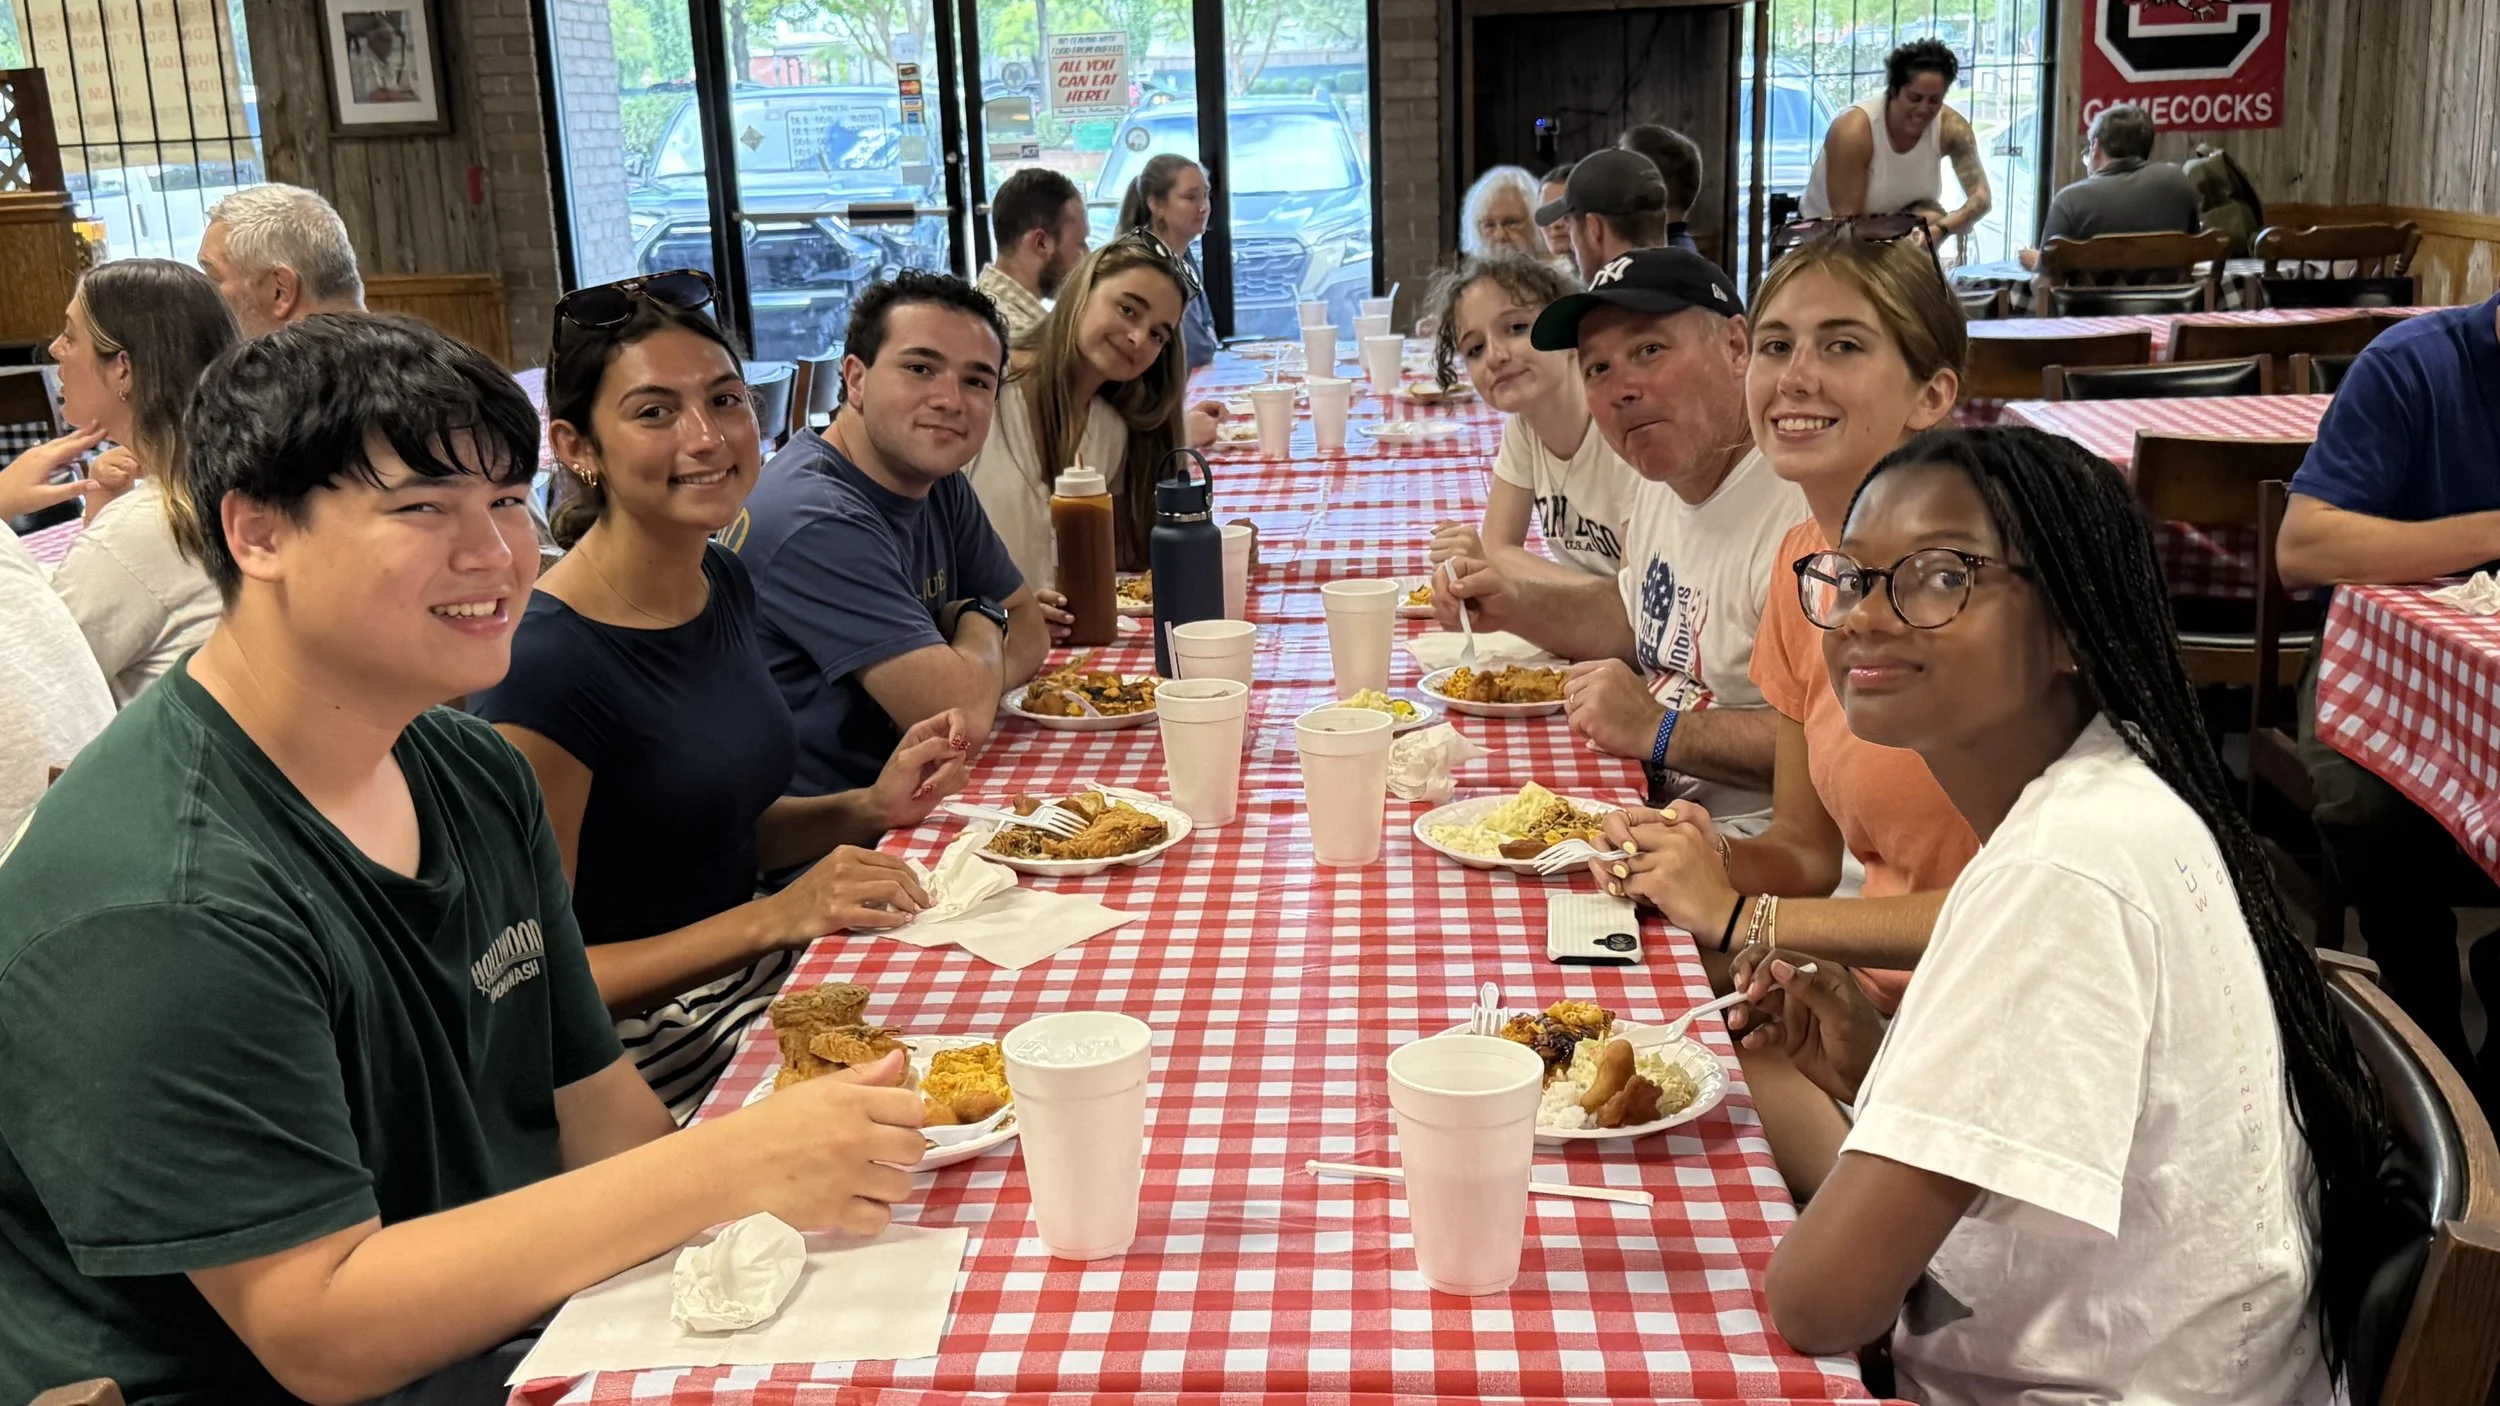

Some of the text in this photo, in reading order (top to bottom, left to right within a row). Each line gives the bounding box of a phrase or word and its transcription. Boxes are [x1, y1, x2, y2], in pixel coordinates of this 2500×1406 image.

[1058, 59, 1116, 73] ALL YOU
[1058, 74, 1118, 88] CAN EAT
[1065, 89, 1110, 102] HERE!
[2083, 93, 2273, 127] GECOCKS
